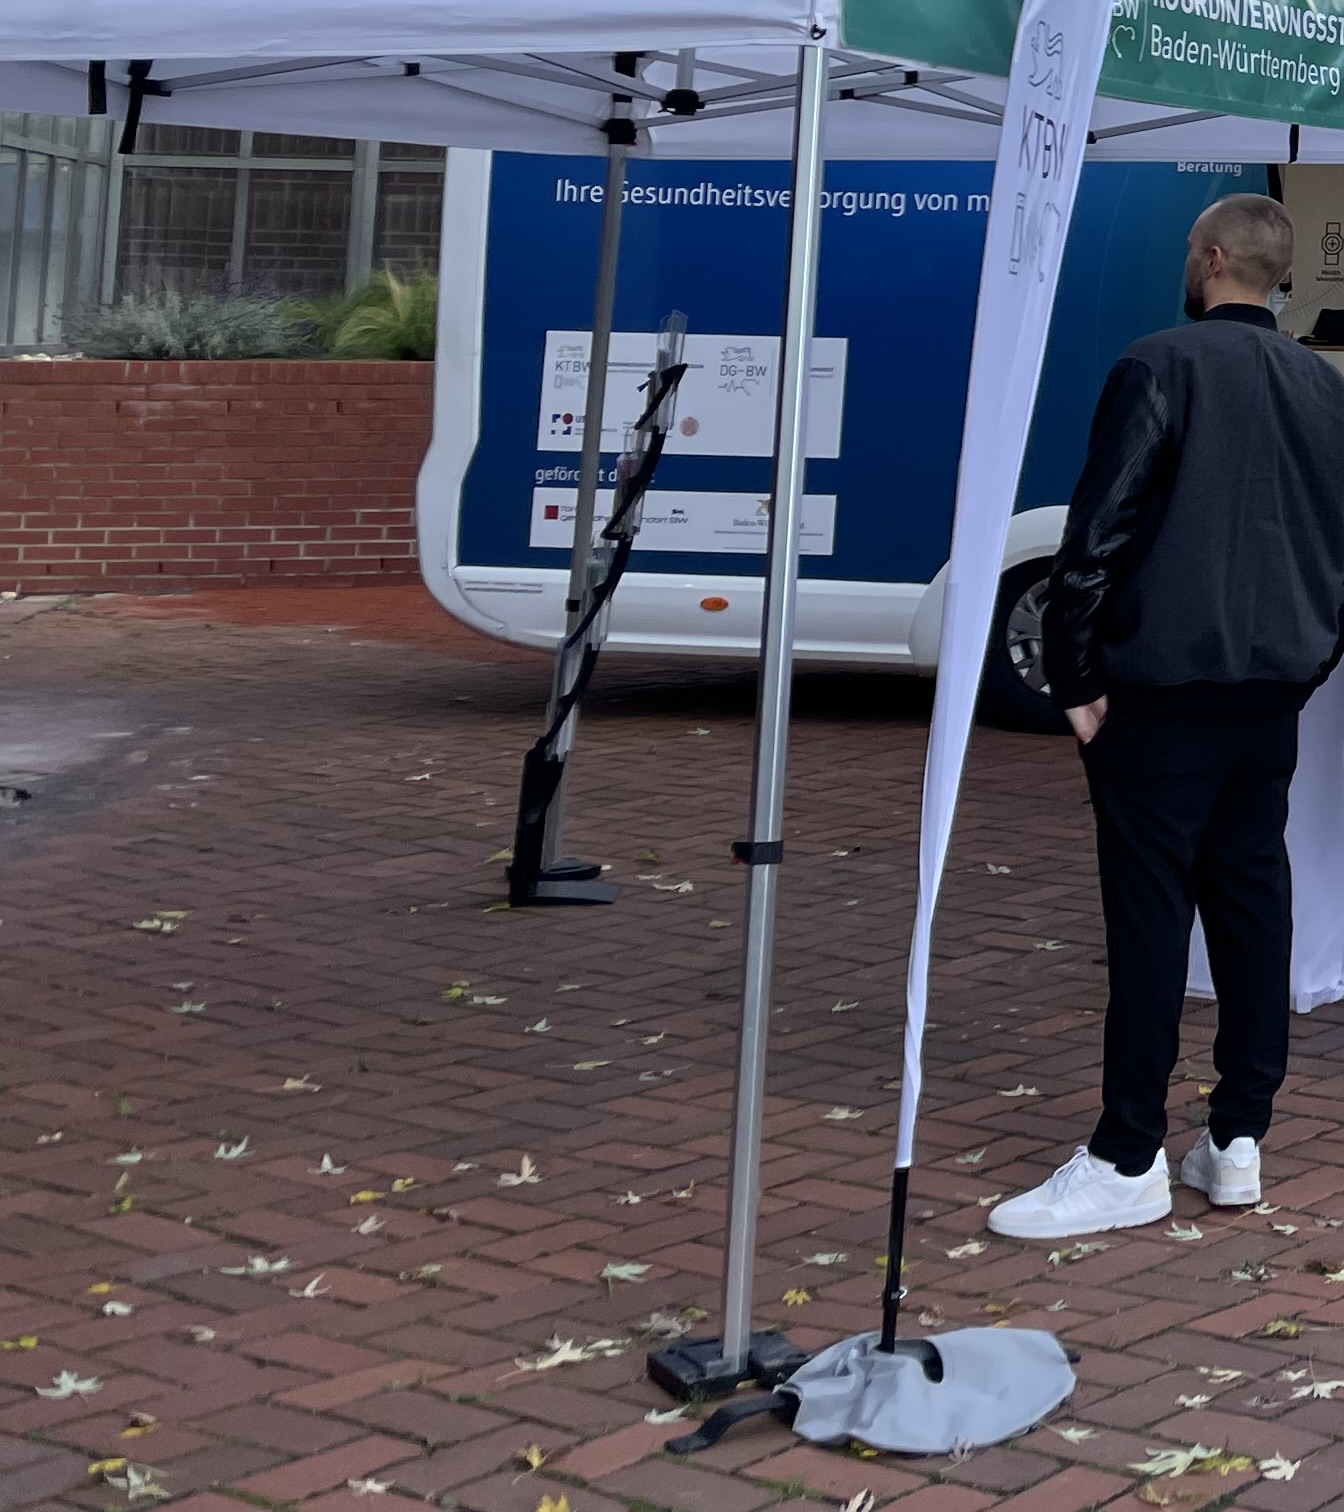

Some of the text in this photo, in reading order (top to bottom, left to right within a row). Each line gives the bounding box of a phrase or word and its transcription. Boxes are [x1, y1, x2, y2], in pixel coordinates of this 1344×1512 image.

[1150, 23, 1341, 96] Baden-Württemberg
[1177, 161, 1243, 177] Beratung
[555, 179, 604, 203] Ihre
[913, 191, 958, 211] von
[720, 364, 767, 377] DG-BW
